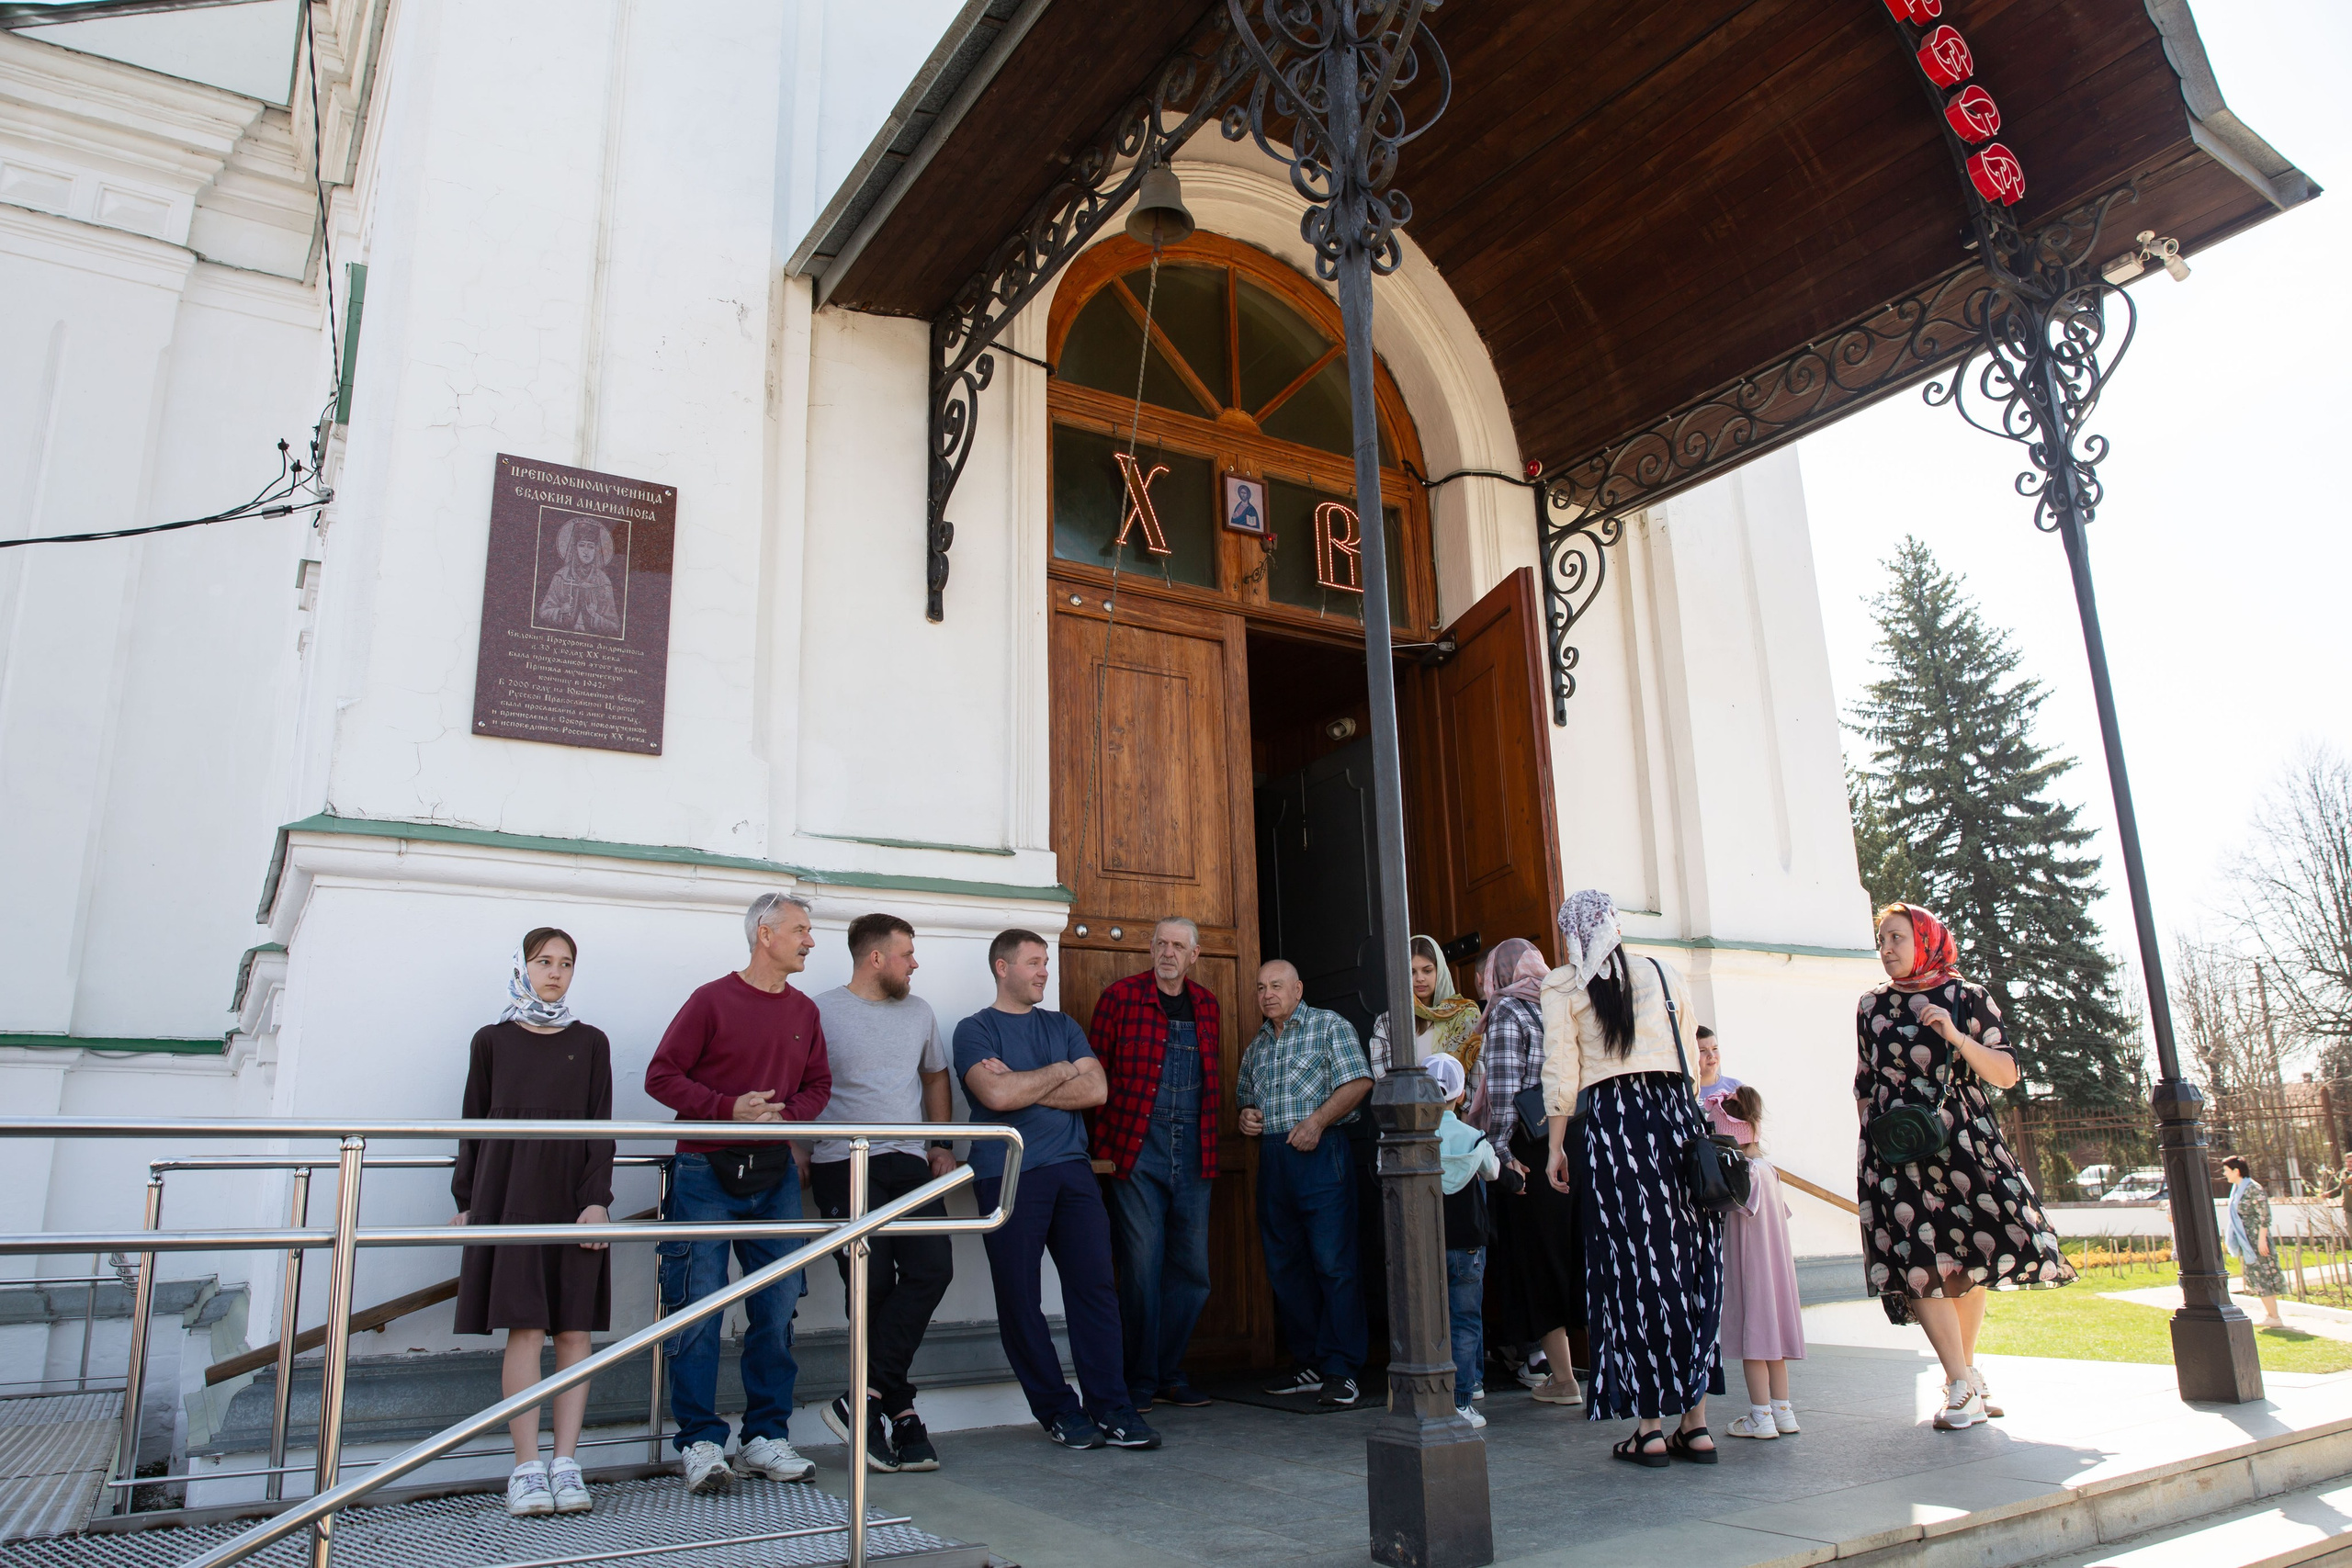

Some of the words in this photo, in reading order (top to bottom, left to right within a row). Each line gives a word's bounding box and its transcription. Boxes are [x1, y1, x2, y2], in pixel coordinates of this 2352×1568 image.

[511, 466, 663, 504] ПРЕПОДОБНОМУЧЕНИЦА
[514, 486, 572, 506] ЕВДОКИЯ
[576, 498, 657, 522] АНДРИАНОВА
[507, 629, 544, 640] Евдокия
[547, 635, 594, 648] Прохоровна
[596, 642, 645, 656] Андрианова
[508, 650, 530, 659] была
[533, 654, 586, 667] прихожанкой
[589, 662, 612, 671] этого
[560, 649, 583, 659] годах
[526, 661, 561, 672] Приняла
[564, 670, 624, 682] мученическую
[508, 679, 530, 689] 2000
[532, 683, 551, 694] году
[567, 687, 615, 700] Юбилейном
[617, 694, 646, 705] Соборе
[538, 675, 571, 686] кончину
[582, 680, 609, 690] 1942г.
[508, 689, 542, 700] Русской
[544, 694, 602, 706] Православной
[605, 702, 636, 713] Церкви
[525, 704, 576, 715] прославлена
[500, 710, 548, 722] причислена
[559, 716, 589, 728] Собору
[501, 720, 559, 732] исповедников
[561, 726, 608, 739] Российских
